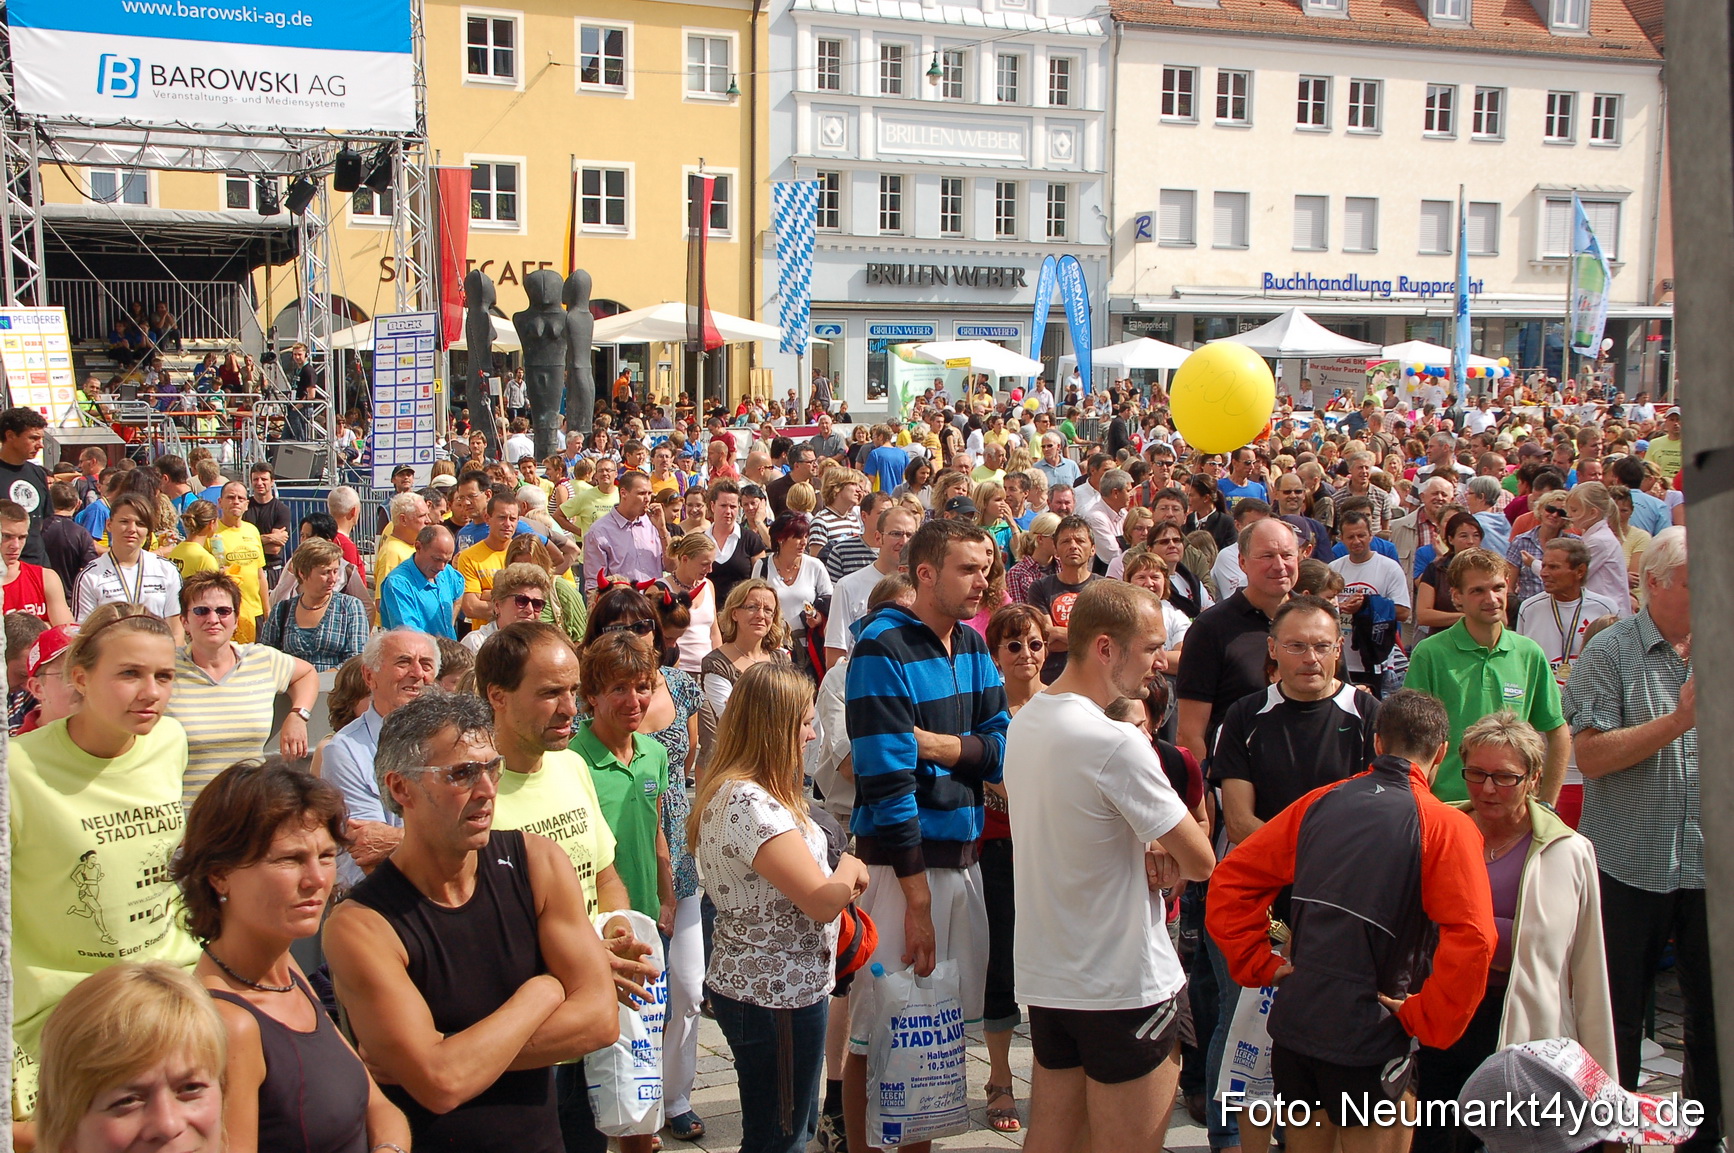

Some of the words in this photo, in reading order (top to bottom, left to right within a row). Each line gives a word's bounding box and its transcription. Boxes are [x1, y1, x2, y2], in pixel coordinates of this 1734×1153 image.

[121, 0, 313, 28] www.barowski-ag.de
[150, 64, 298, 94] BAROWSKI
[308, 75, 346, 97] AG
[153, 90, 238, 104] Veranstaltungs-
[242, 95, 262, 104] und
[265, 96, 346, 109] Mediensysteme
[885, 125, 953, 146] BRILLEN
[957, 129, 1021, 150] WEBER
[1135, 215, 1151, 239] R
[866, 263, 948, 286] BRILLEN
[952, 265, 1028, 287] WEBER
[1262, 272, 1392, 297] Buchhandlung
[1398, 275, 1484, 297] Ruppreht
[13, 315, 61, 324] PFLEIDERER
[1137, 321, 1168, 331] Rupprecht
[873, 325, 903, 335] BRILLEN
[904, 326, 931, 335] WEBER
[960, 327, 988, 336] BRILLEN
[990, 327, 1016, 336] WEBER
[1343, 366, 1366, 374] Partne
[96, 815, 183, 845] STADTLAUF
[543, 820, 588, 842] DTLAUF
[77, 949, 115, 959] Danke
[118, 944, 142, 957] Euer
[890, 1007, 962, 1030] Neumakter
[1235, 1048, 1257, 1063] LEBEN
[1237, 1041, 1259, 1056] DKMS
[928, 1061, 945, 1072] 10,5
[880, 1082, 905, 1091] DKMS
[880, 1091, 905, 1100] LEBEN
